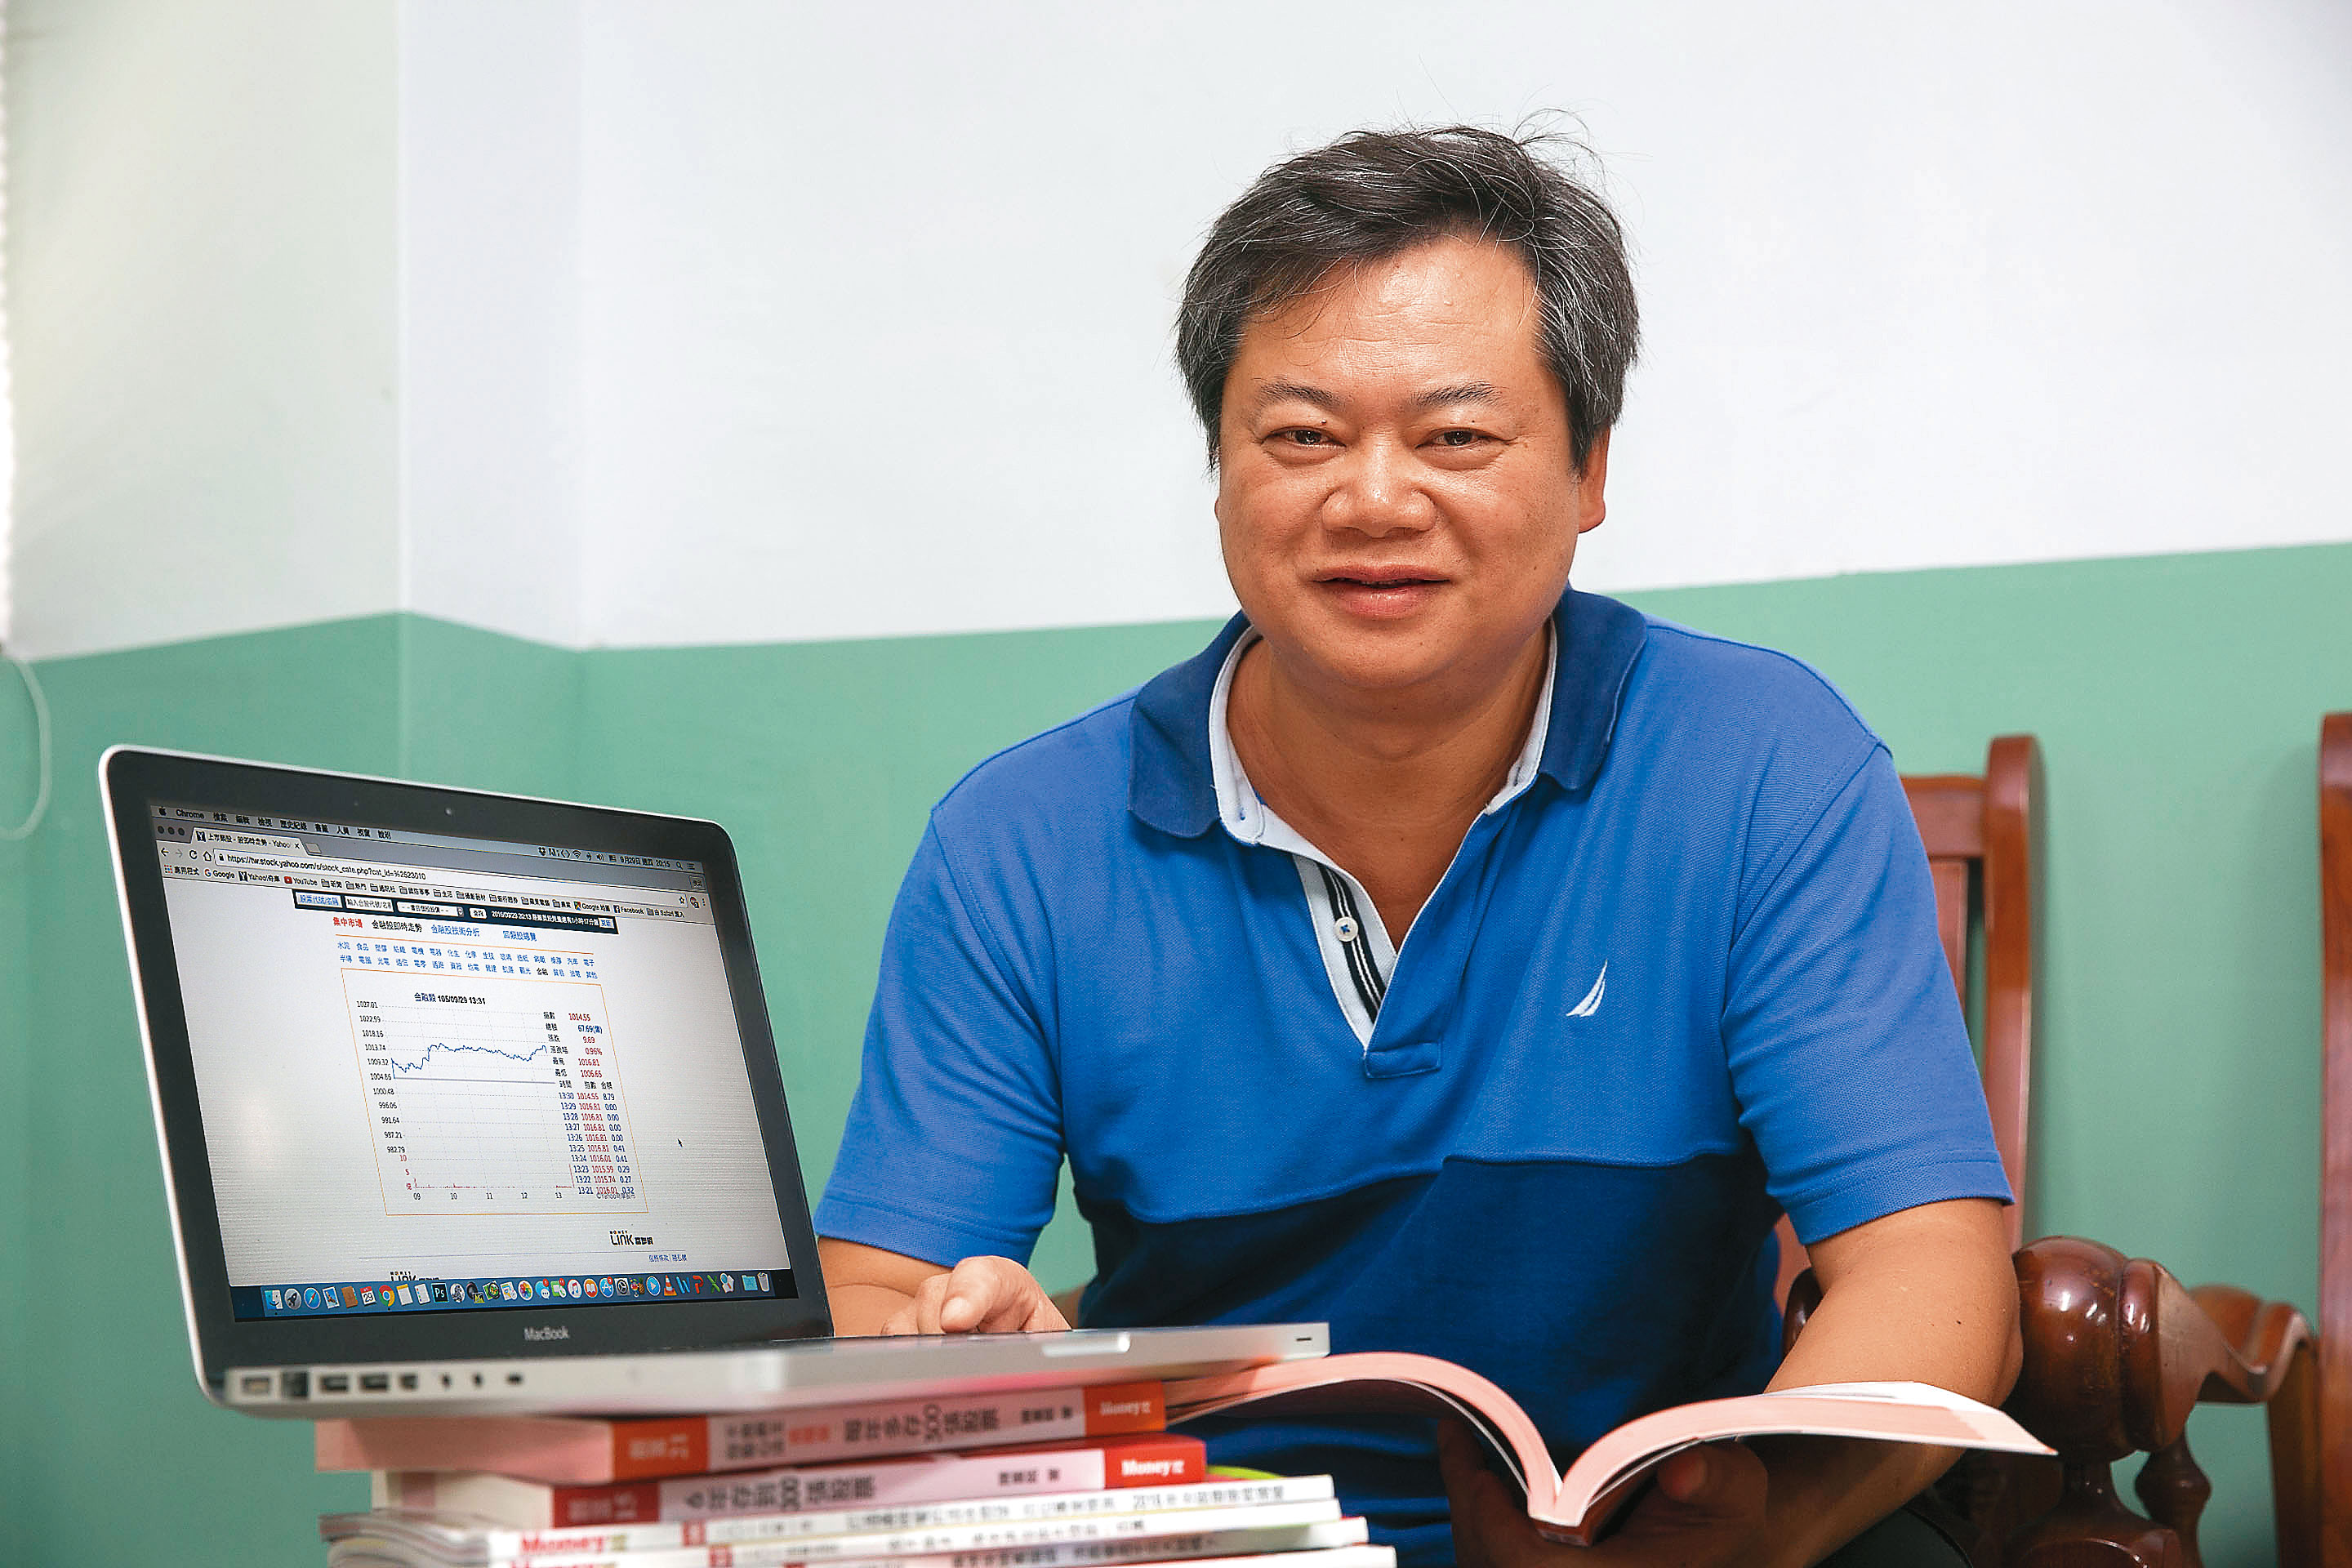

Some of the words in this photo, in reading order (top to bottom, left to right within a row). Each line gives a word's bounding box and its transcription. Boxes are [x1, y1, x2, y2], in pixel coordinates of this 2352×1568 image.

[176, 809, 204, 819] Chrome
[336, 826, 350, 835] 人員
[620, 856, 640, 865] 9月29日
[656, 859, 670, 868] 20:15
[174, 866, 200, 875] 應用程式
[212, 870, 235, 880] Google
[293, 877, 318, 886] YouTube
[442, 890, 453, 898] 生活
[581, 902, 599, 911] Google
[621, 906, 644, 915] Facebook
[332, 916, 363, 929] 集中市場
[372, 920, 423, 933] 金融股即時走勢
[430, 924, 480, 938] 金融股技術分析
[356, 942, 369, 951] 食品
[437, 995, 468, 1004] 105/09/29
[468, 996, 486, 1004] 13:31
[356, 1000, 378, 1009] 1027.01
[359, 1015, 381, 1023] 1022.59
[568, 1013, 590, 1022] 1014.55
[585, 1047, 603, 1055] 0.96%
[578, 1058, 600, 1067] 1016.81
[559, 1092, 574, 1100] 13:30
[603, 1093, 615, 1101] 8.79
[578, 1102, 601, 1111] 1016.81
[565, 1123, 580, 1131] 13:27
[583, 1124, 606, 1132] 1016.81
[608, 1124, 621, 1132] 0.00
[567, 1134, 583, 1142] 13:26
[585, 1134, 608, 1142] 1016.81
[569, 1144, 585, 1152] 13:25
[587, 1144, 610, 1152] 1016.81
[615, 1155, 628, 1163] 0.41
[575, 1175, 591, 1183] 13:22
[594, 1175, 616, 1183] 1015.74
[577, 1187, 594, 1195] 13:21
[521, 1192, 528, 1200] 12
[610, 1234, 635, 1246] LINK
[363, 1292, 375, 1303] 29
[435, 1287, 445, 1298] Ps
[523, 1326, 570, 1342] MacBook
